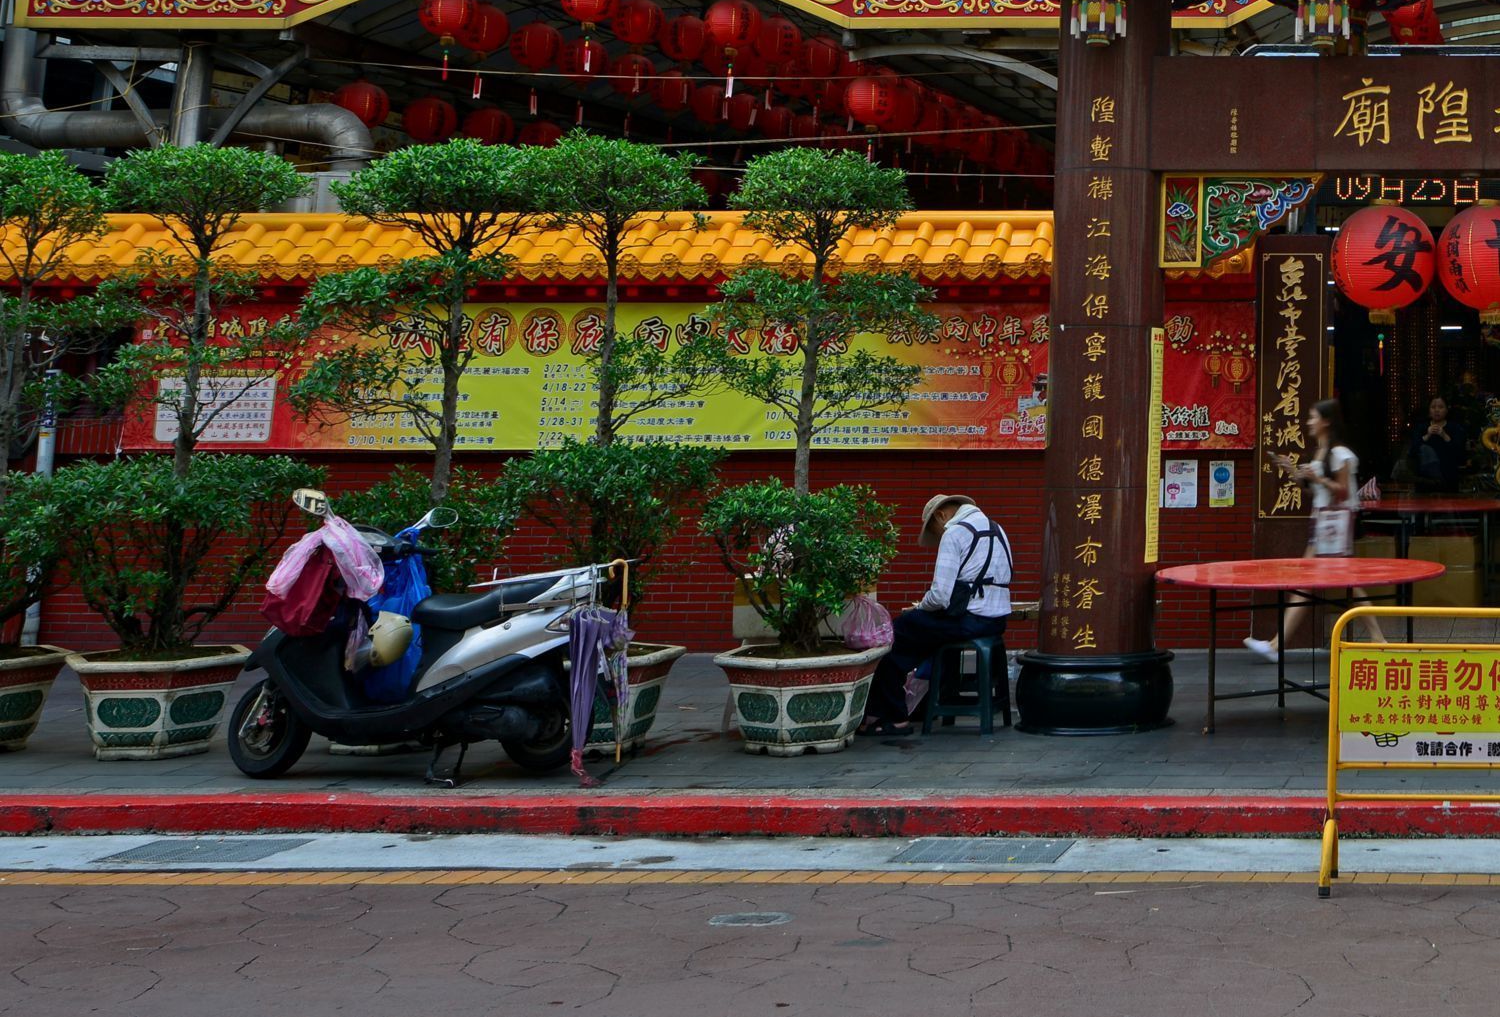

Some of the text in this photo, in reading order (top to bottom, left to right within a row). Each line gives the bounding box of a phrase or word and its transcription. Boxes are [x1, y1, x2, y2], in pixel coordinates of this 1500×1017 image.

[1361, 215, 1434, 293] 安
[1165, 315, 1193, 343] 動
[543, 364, 570, 373] 3/27
[542, 382, 587, 392] 4/18-22
[540, 397, 567, 407] 5/14
[539, 417, 584, 426] 5/28-31
[538, 431, 563, 441] 7/22
[764, 430, 792, 439] 10/25
[348, 435, 394, 445] 3/10-14
